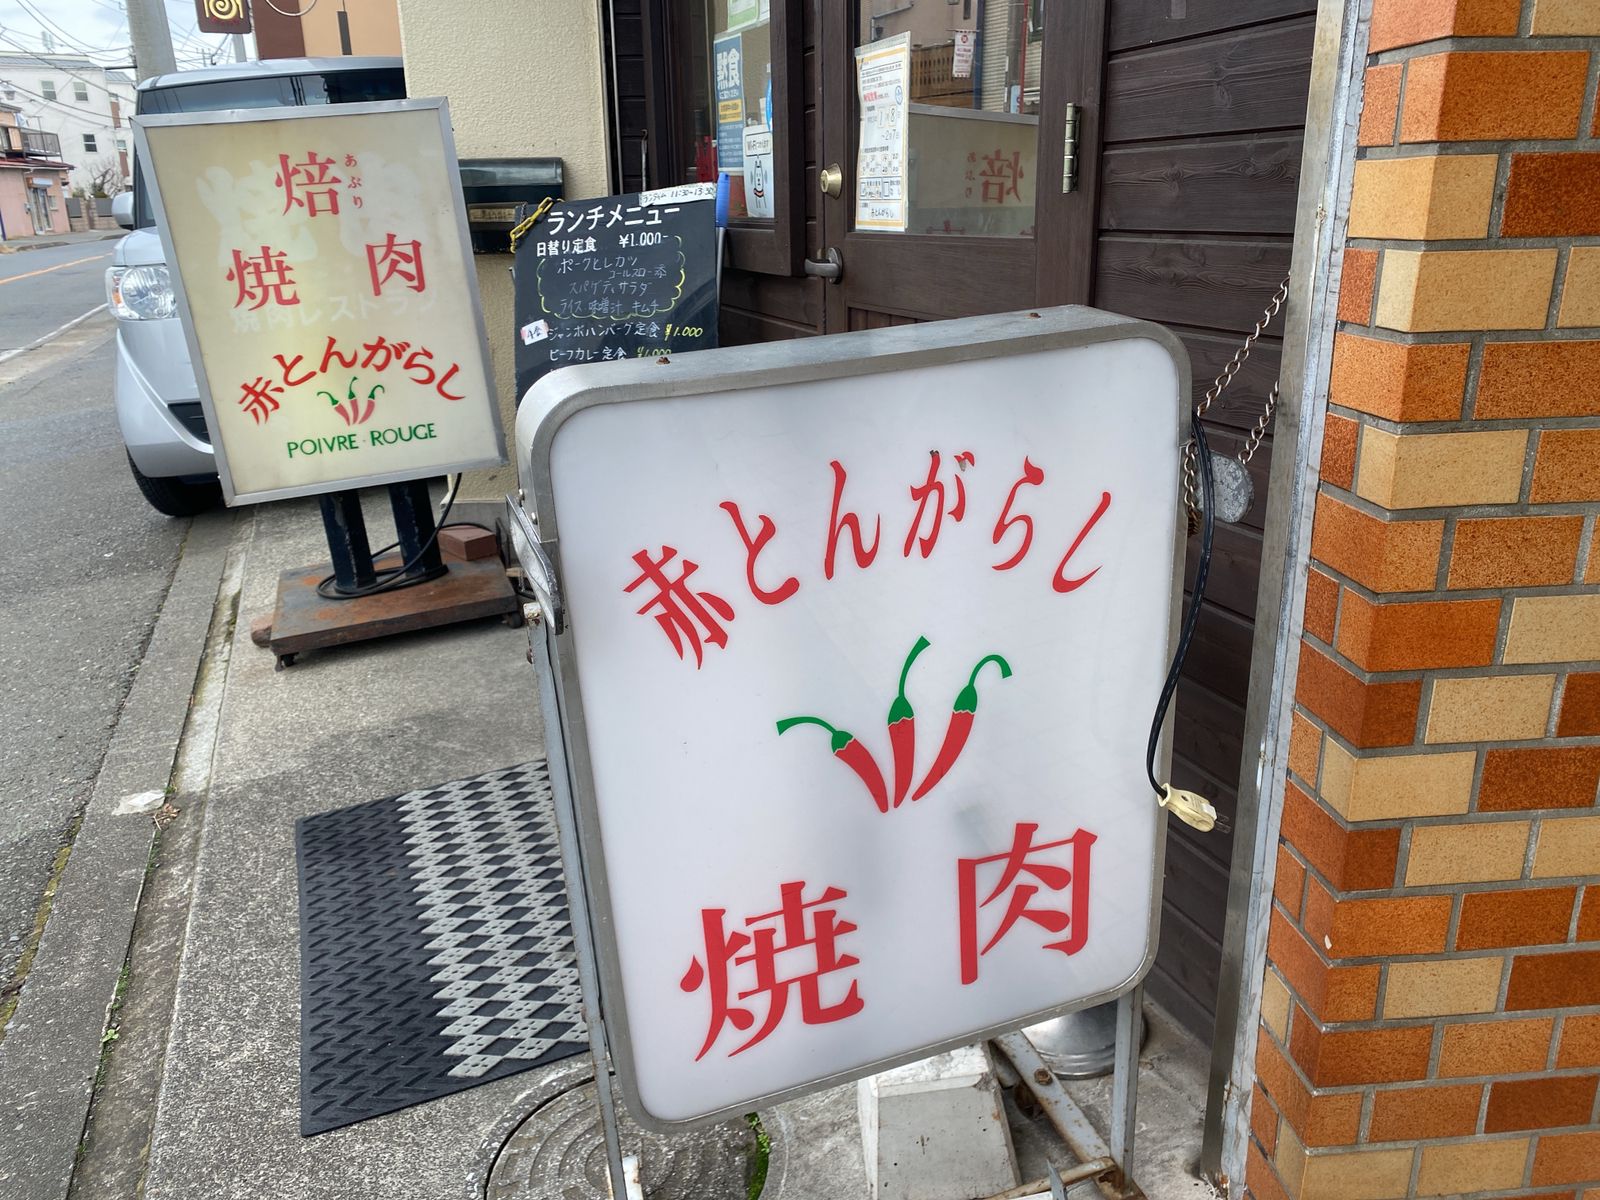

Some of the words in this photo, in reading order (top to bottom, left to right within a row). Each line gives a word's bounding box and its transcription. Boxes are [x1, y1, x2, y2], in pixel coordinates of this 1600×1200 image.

[275, 151, 342, 218] 焙
[344, 153, 364, 209] あぶり
[536, 236, 597, 257] 日替り定食
[548, 204, 681, 236] ランチメニュー
[238, 336, 466, 426] 赤とんがらし
[287, 433, 360, 459] POIVRE
[370, 422, 438, 447] ROUGE
[623, 449, 1112, 671] 赤とんがらし
[680, 822, 1098, 1062] 焼肉
